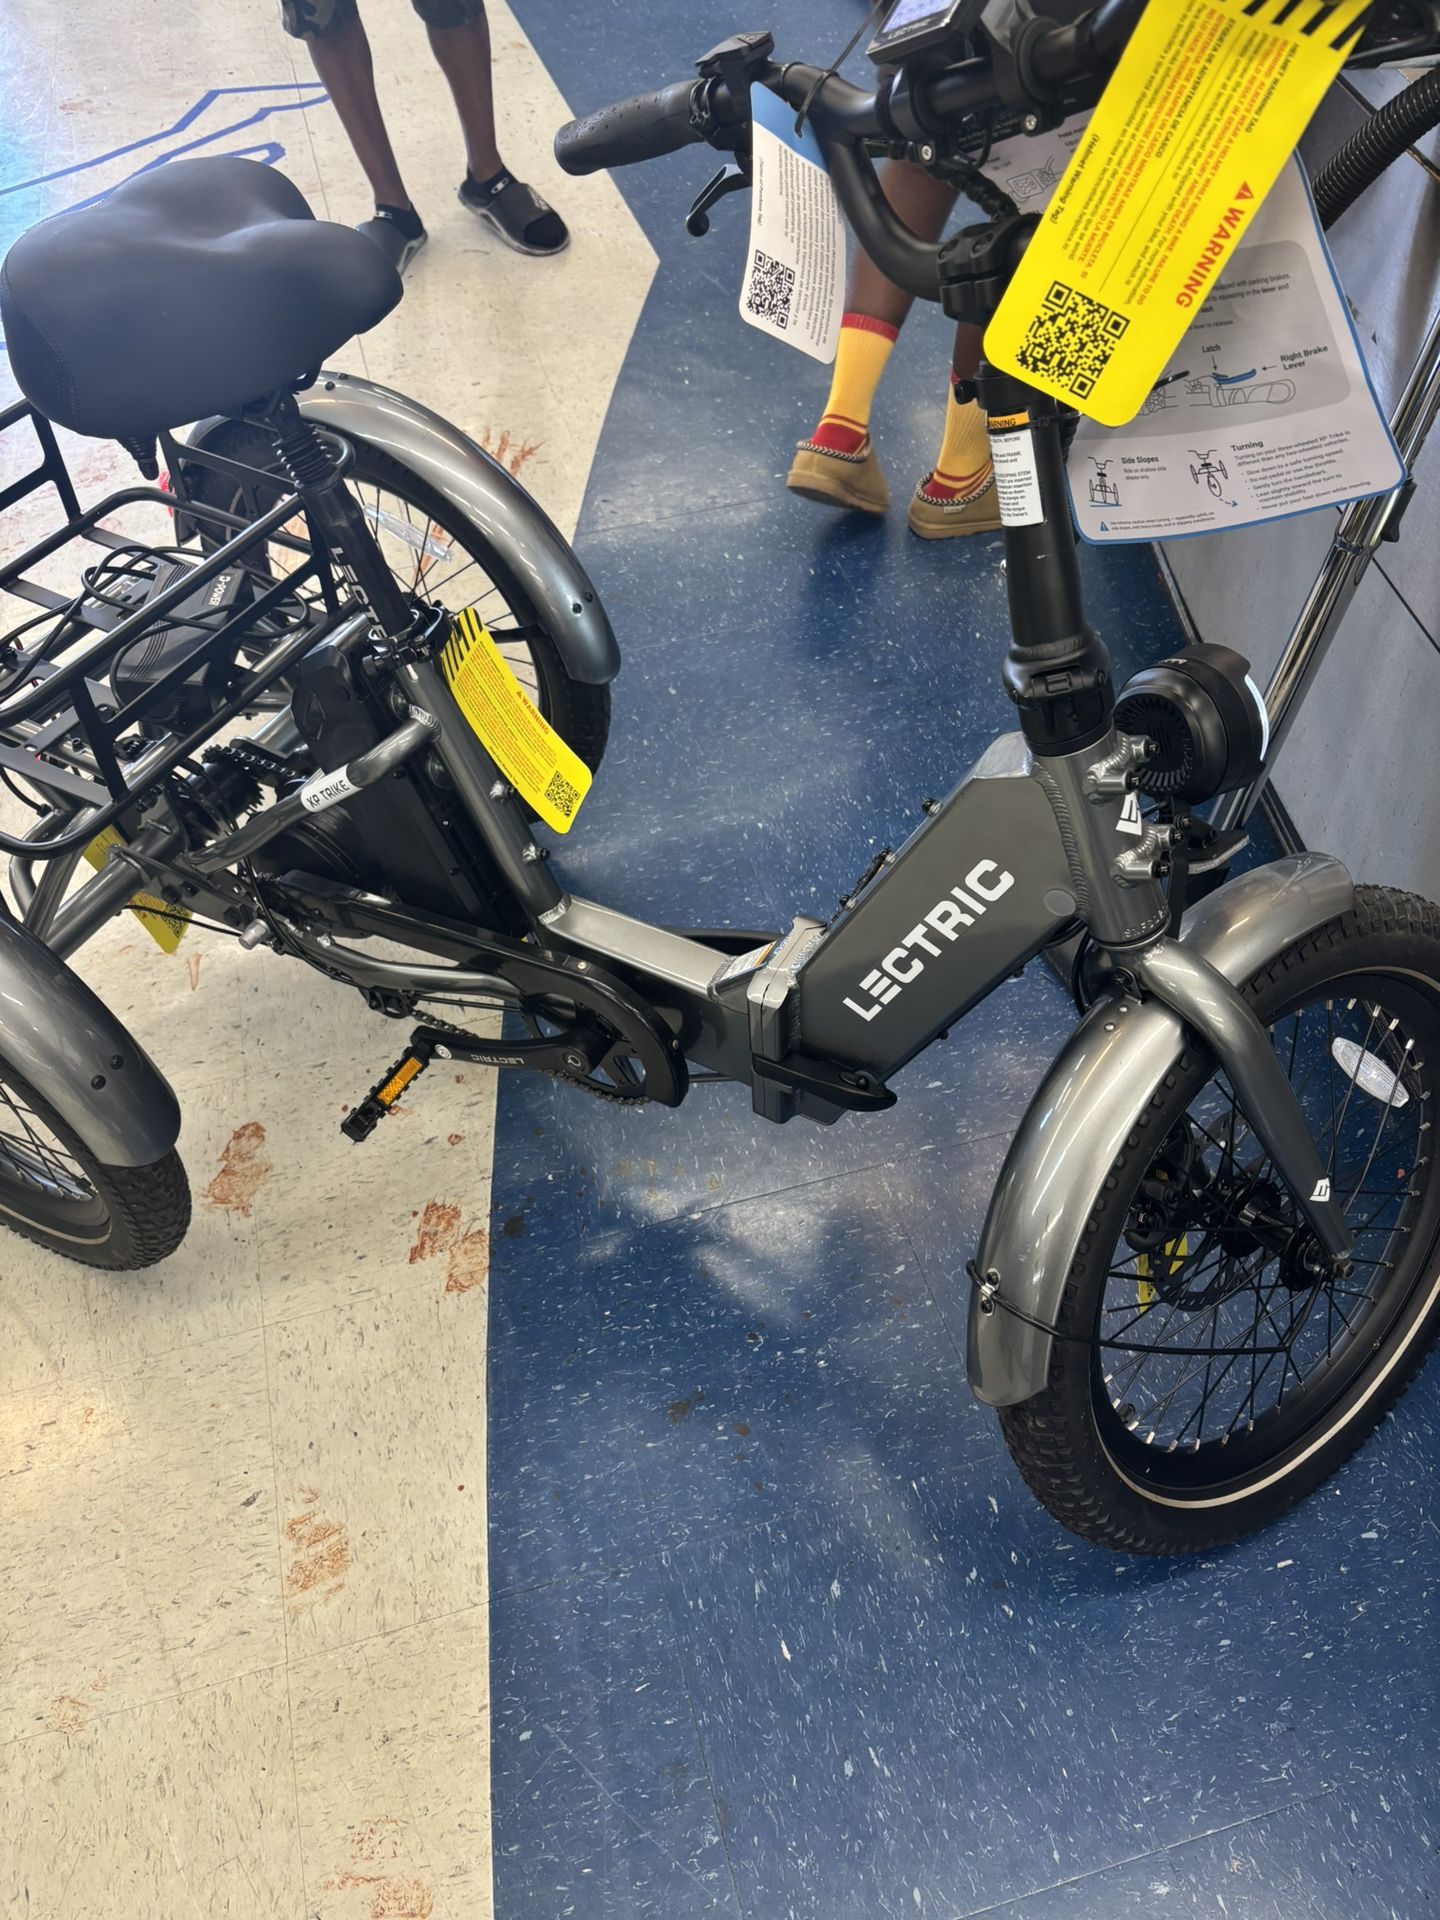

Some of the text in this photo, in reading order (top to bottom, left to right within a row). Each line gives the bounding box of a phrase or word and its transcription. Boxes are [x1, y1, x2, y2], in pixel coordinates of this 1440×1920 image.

[1206, 53, 1216, 65] DE
[1176, 65, 1209, 119] ADVERTENCIA
[1231, 80, 1241, 93] the
[1237, 75, 1257, 104] RESULT
[1243, 81, 1265, 113] ALWAYS
[1245, 43, 1298, 134] HELMET WARNING TAG
[1165, 84, 1187, 119] SIEMPRE
[1231, 105, 1239, 115] IN
[1142, 91, 1172, 139] PRODUCIRSE
[1158, 119, 1168, 131] UN
[1170, 119, 1180, 130] DE
[1230, 114, 1246, 137] WEAR
[1199, 123, 1218, 151] manual
[1212, 115, 1234, 149] SERIOUS
[1077, 134, 1100, 169] (Helmet
[1143, 131, 1162, 159] CASCO
[1155, 131, 1173, 159] CASCO
[1123, 140, 1146, 176] LESIONES
[1190, 151, 1202, 166] that
[1196, 150, 1214, 178] INJURY
[1208, 145, 1229, 176] HELMET
[1059, 169, 1082, 205] Warning
[1122, 158, 1147, 198] MIENTRAS
[1174, 167, 1193, 195] shipped
[1194, 177, 1211, 201] WHILE
[1107, 177, 1126, 207] GRAVES
[1178, 179, 1198, 209] AND/OR
[1049, 204, 1064, 224] Tag)
[1111, 199, 1126, 220] ANDA
[1165, 196, 1177, 212] with
[1179, 202, 1197, 228] RIDING
[1093, 221, 1102, 232] LA
[1105, 220, 1114, 231] EN
[1156, 212, 1168, 228] your
[1139, 245, 1150, 258] and
[1157, 236, 1166, 248] For
[1128, 258, 1142, 279] which
[1146, 248, 1159, 267] more
[1176, 207, 1245, 308] WARNING
[1148, 255, 1168, 284] FAILURE
[1143, 284, 1151, 294] TO
[1136, 295, 1145, 306] DO
[1201, 343, 1221, 353] Latch
[1280, 345, 1328, 363] Right Brake
[1283, 361, 1305, 370] Lever
[1231, 440, 1263, 452] Turning
[1235, 452, 1255, 460] Turning
[1277, 438, 1318, 451] three-wheeled
[1237, 458, 1259, 466] different
[1286, 444, 1322, 456] two-wheeled
[1303, 453, 1324, 462] turning
[1253, 482, 1270, 490] Gently
[1271, 485, 1290, 494] slightly
[1259, 494, 1283, 502] maintain
[208, 575, 231, 605] D-POWER
[519, 695, 552, 736] WARNING
[305, 779, 350, 808] XP TRIKE
[843, 859, 1015, 1022] LECTRIC
[469, 1053, 524, 1065] LECTRIC
